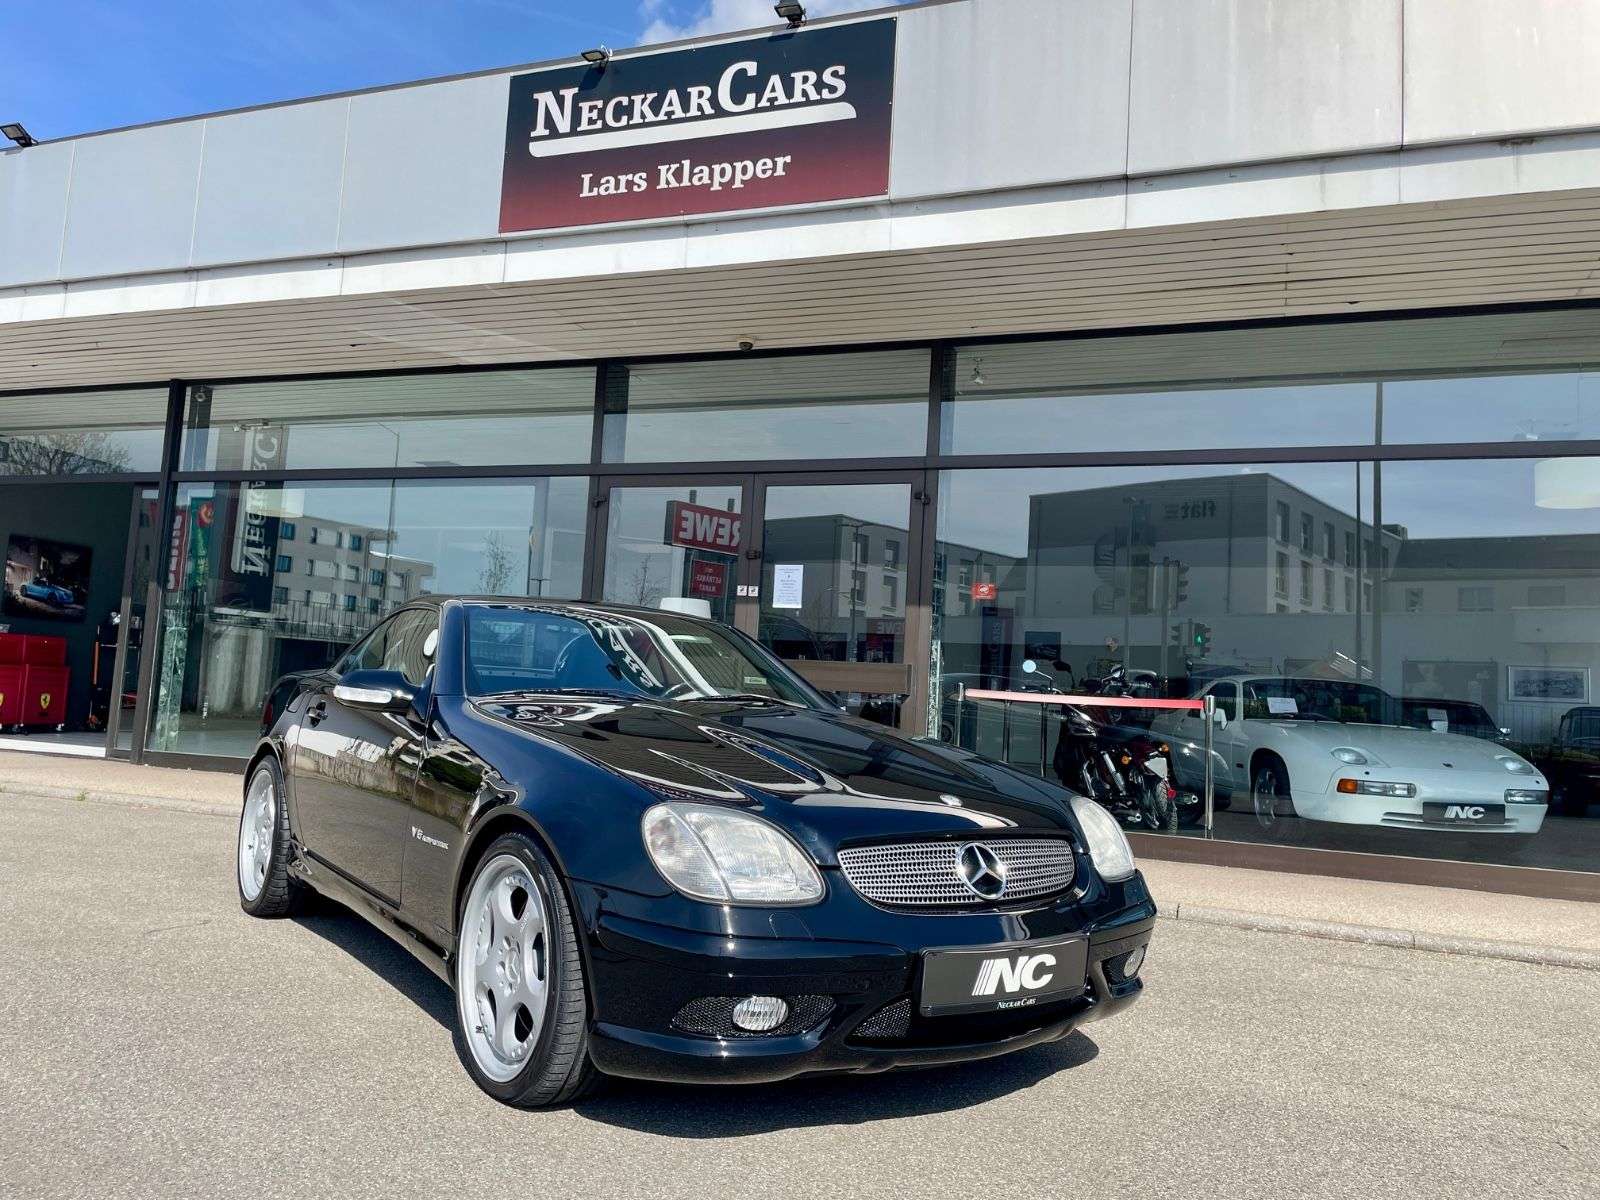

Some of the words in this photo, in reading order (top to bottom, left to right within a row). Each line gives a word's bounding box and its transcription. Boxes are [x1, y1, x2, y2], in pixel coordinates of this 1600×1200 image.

[579, 172, 648, 198] Lars
[656, 154, 792, 191] Klapper
[971, 953, 1057, 996] NC
